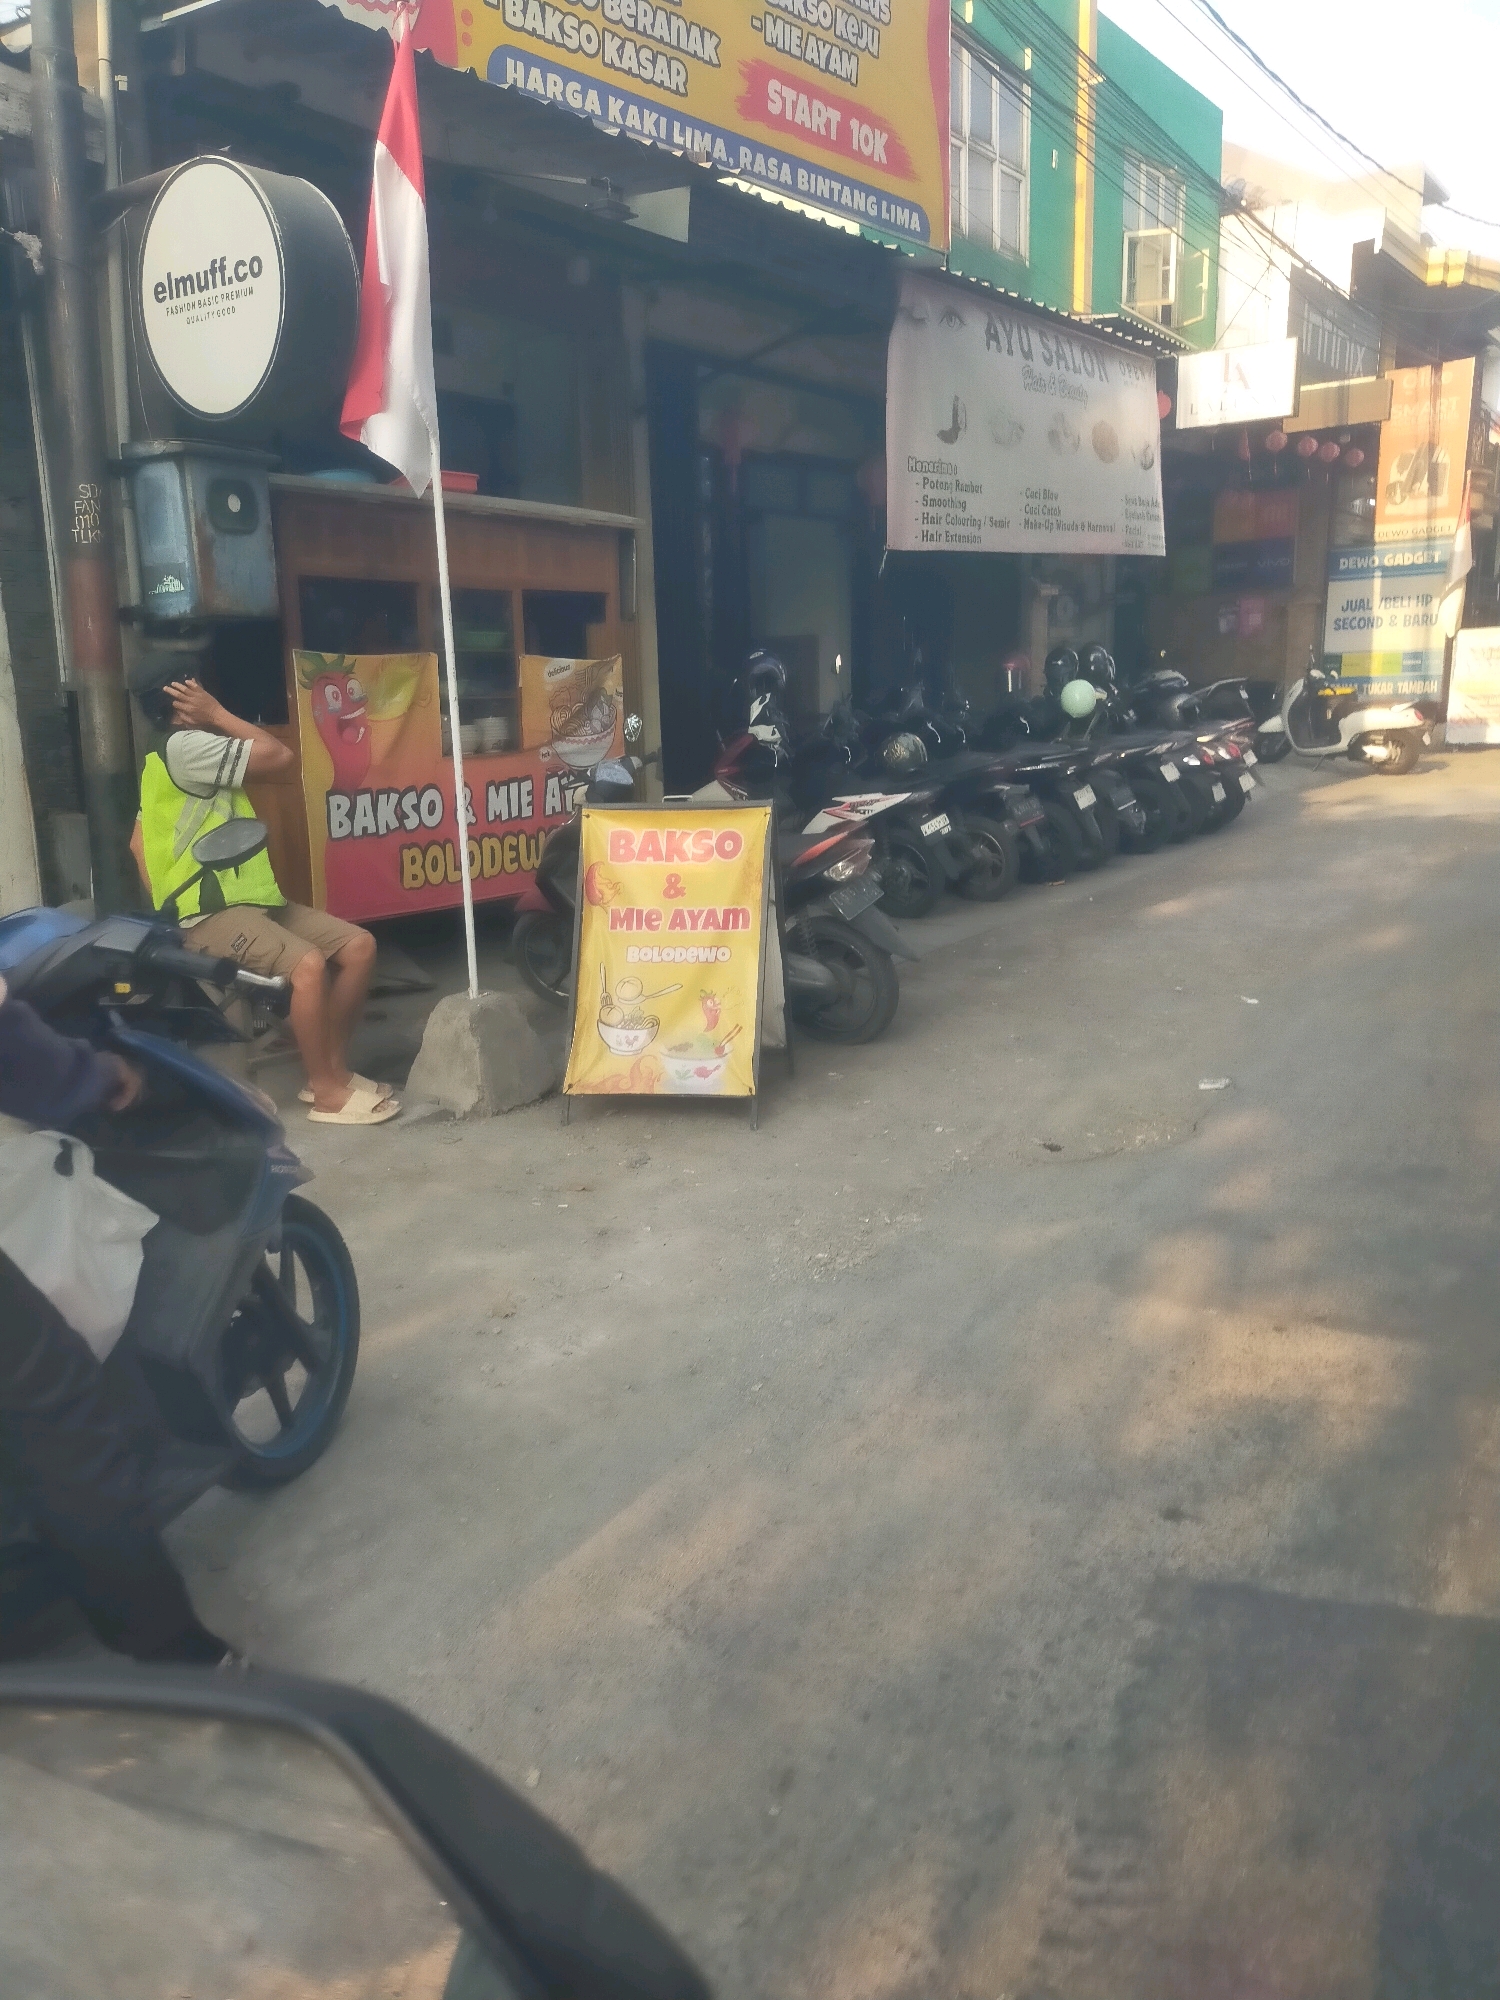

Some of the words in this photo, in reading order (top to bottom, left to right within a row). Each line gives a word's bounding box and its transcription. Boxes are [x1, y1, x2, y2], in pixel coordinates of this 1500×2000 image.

[503, 0, 600, 56] BAKSO
[603, 29, 689, 95] KASAR
[764, 12, 803, 60] MIE
[803, 32, 859, 86] AYAM
[767, 78, 842, 141] START
[850, 117, 889, 165] 10K
[506, 56, 602, 116] HARGA
[608, 94, 668, 140] KAKI
[673, 120, 734, 166] LIMA,
[739, 145, 793, 186] RASA
[797, 168, 878, 217] BINTANG
[881, 199, 922, 232] LIMA
[153, 255, 263, 304] elmuff.co
[166, 299, 196, 317] FASHION
[197, 294, 219, 309] BASIC
[220, 286, 254, 302] PREMIUM
[186, 310, 215, 325] QUALITY
[216, 305, 236, 318] GOOD
[984, 311, 1035, 362] AYU
[1038, 330, 1110, 383] SALON
[921, 494, 967, 513] Smoothing
[1025, 487, 1041, 501] Cuci
[921, 512, 943, 526] Hair
[945, 513, 982, 531] Colouring
[1024, 503, 1041, 516] Cuci
[921, 529, 943, 543] Hair
[944, 530, 982, 545] Extension
[1338, 555, 1380, 570] DEWO
[1383, 550, 1442, 566] GADGET
[1341, 598, 1372, 613] JUAL
[1415, 594, 1433, 608] HP
[1333, 615, 1384, 632] SECOND
[1388, 615, 1398, 628] &
[1402, 613, 1438, 628] BARU
[547, 663, 572, 679] delicious
[1363, 681, 1394, 695] TUKAR
[1397, 679, 1438, 695] TAMBAH
[328, 787, 444, 840] BAKSO
[487, 778, 534, 823] MIE
[608, 827, 744, 864] BAKSO
[401, 830, 551, 890] BOLODEW
[662, 872, 687, 900] &
